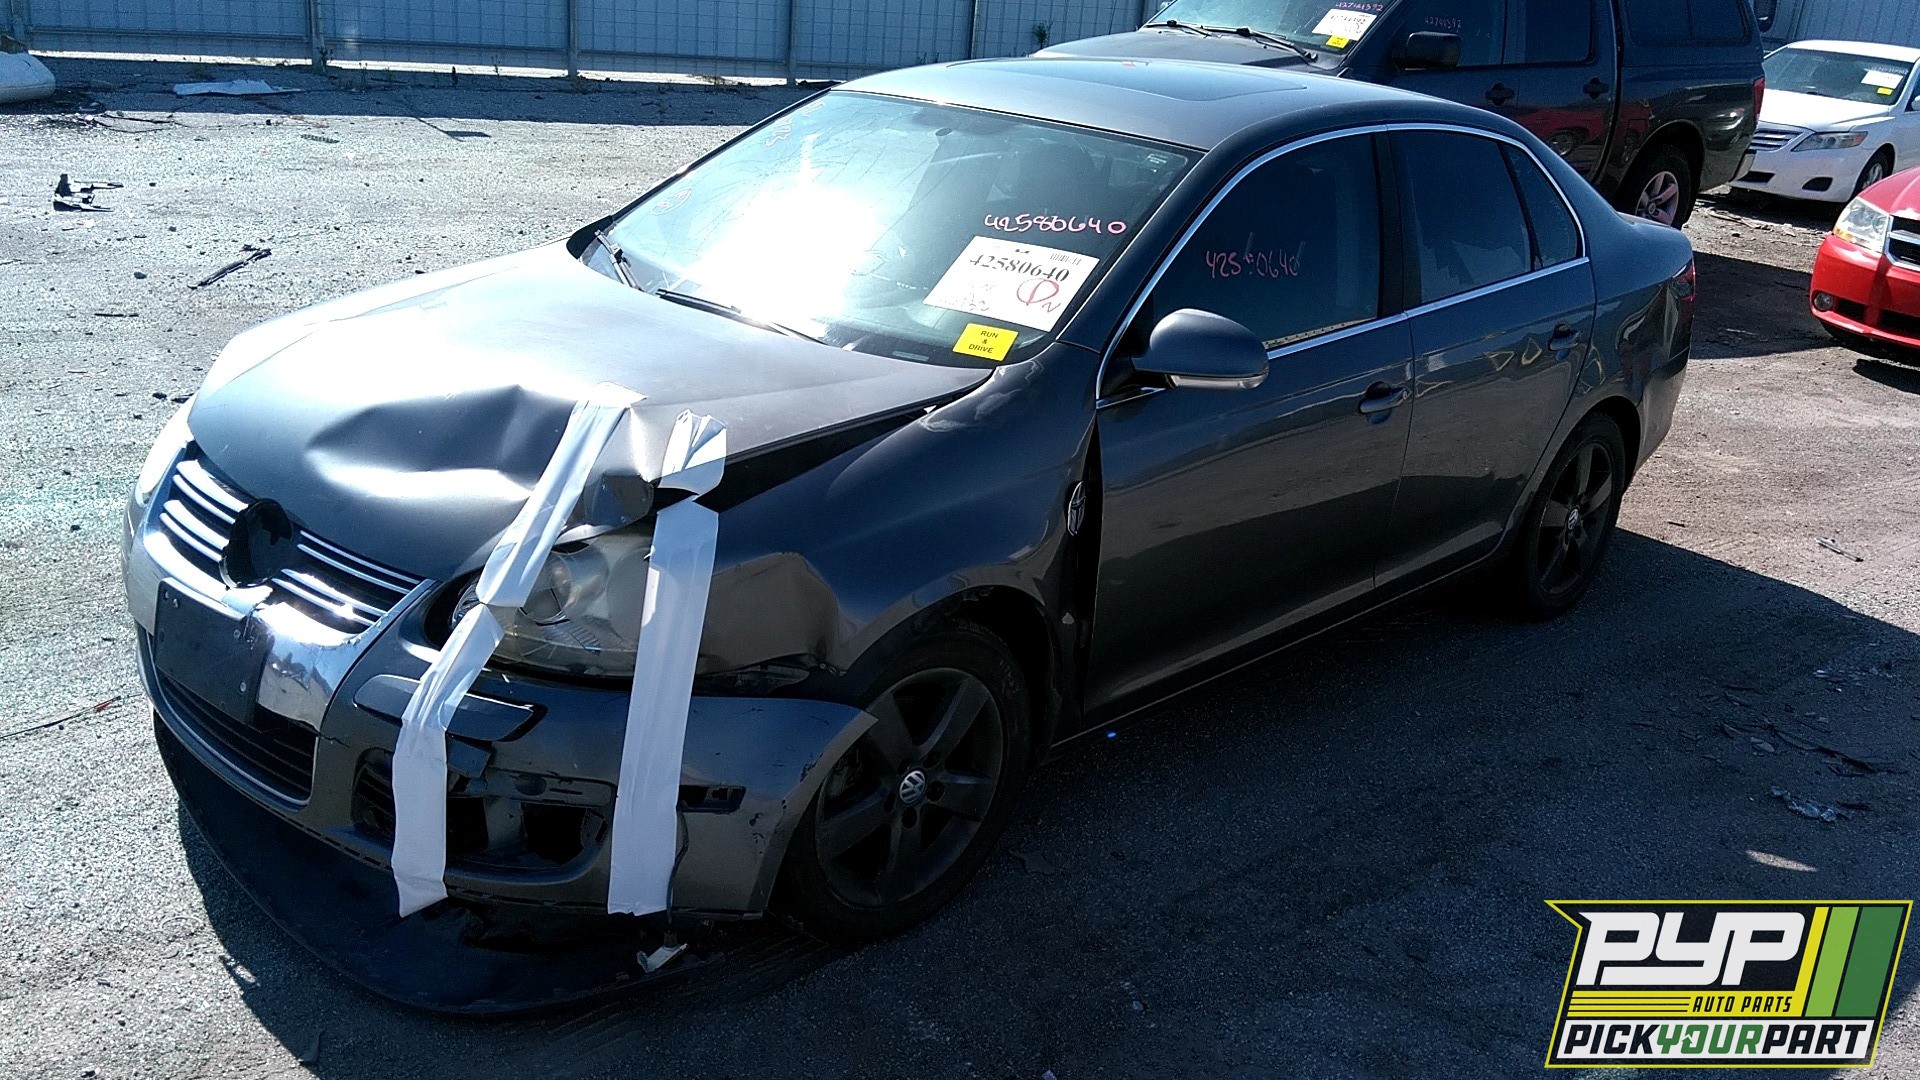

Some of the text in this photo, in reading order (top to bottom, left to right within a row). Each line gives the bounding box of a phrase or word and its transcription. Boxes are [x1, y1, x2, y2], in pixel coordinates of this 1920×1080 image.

[984, 213, 1127, 234] 42580640
[969, 253, 1070, 283] 42580640
[980, 330, 999, 339] RUN
[968, 343, 994, 354] DRIVE
